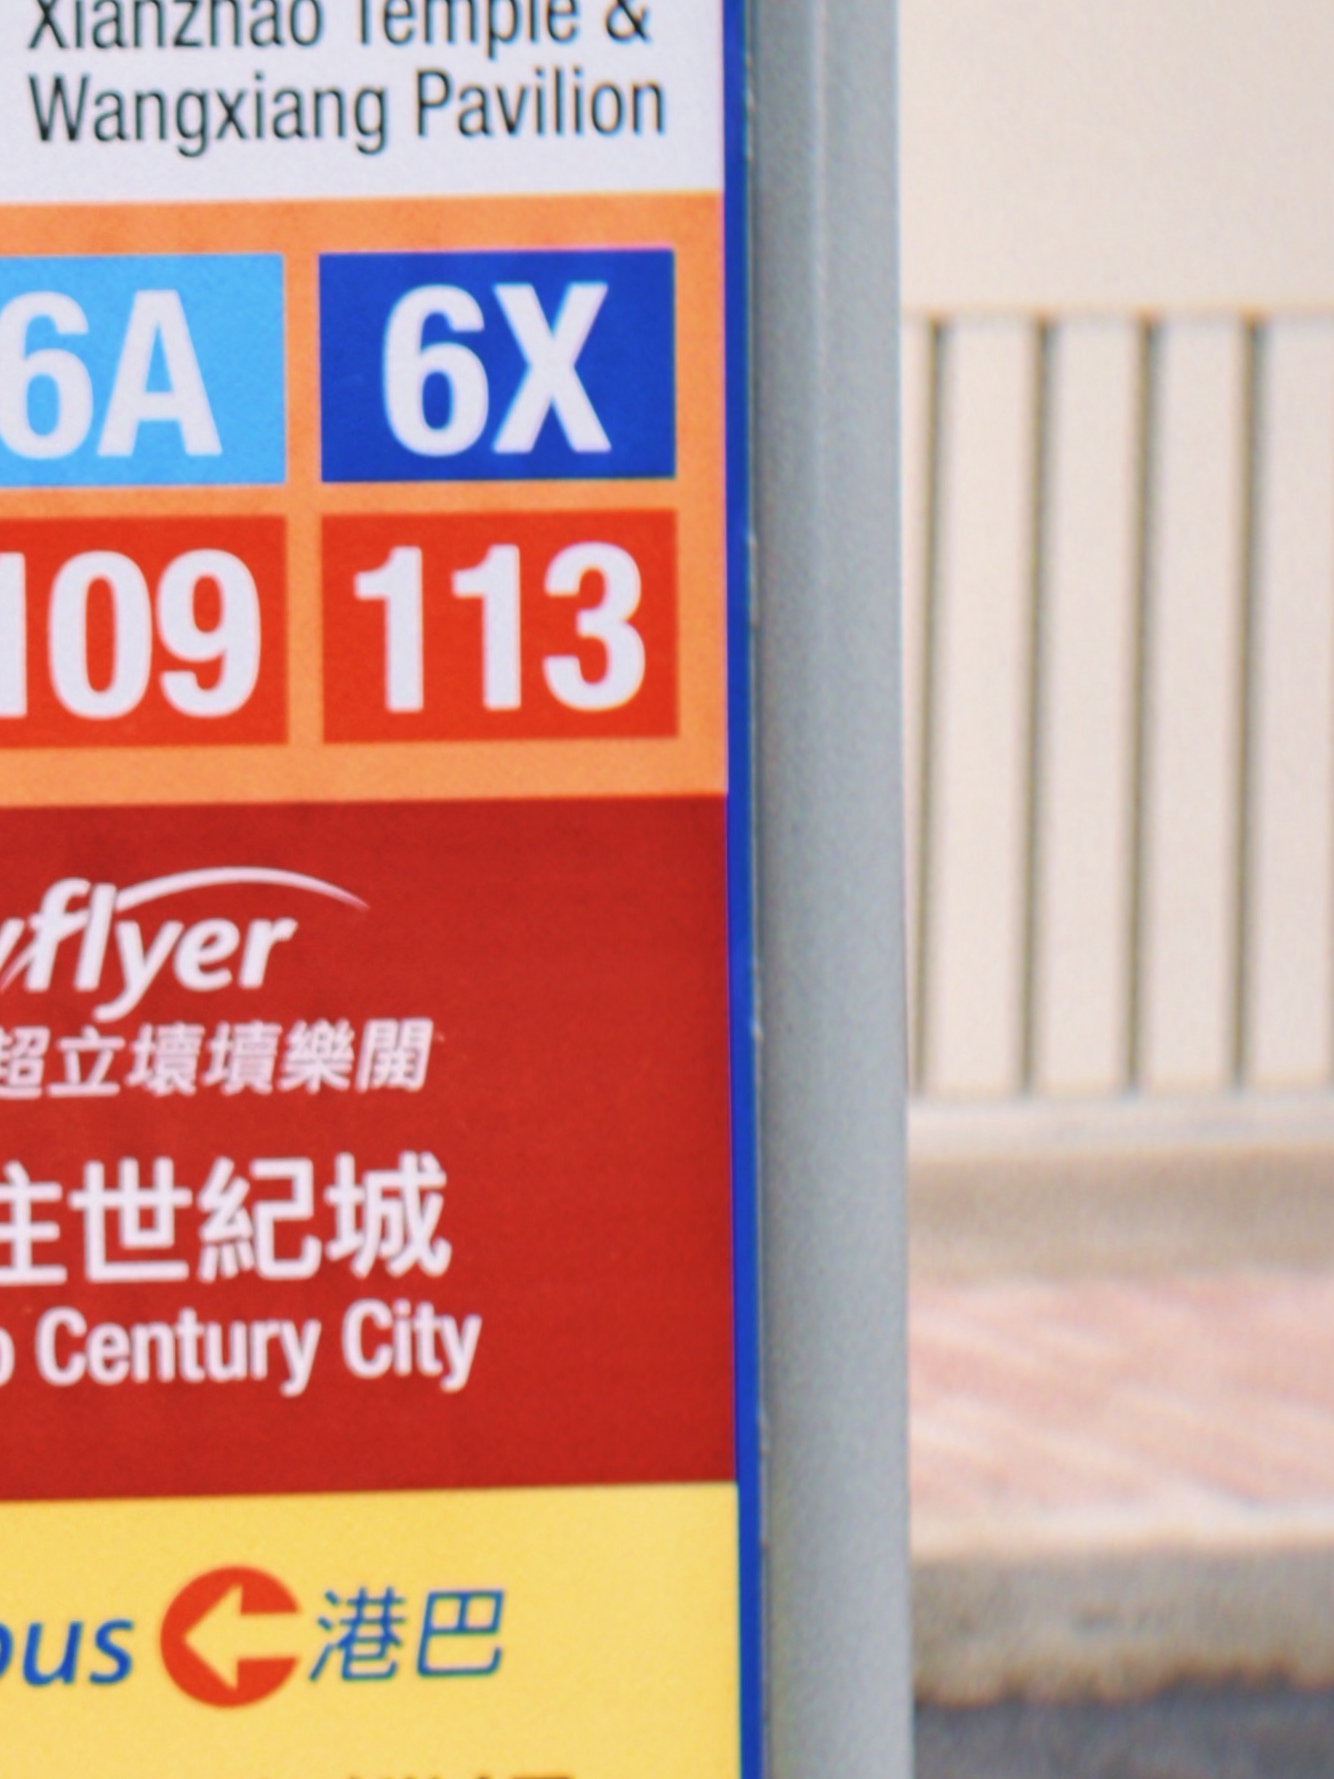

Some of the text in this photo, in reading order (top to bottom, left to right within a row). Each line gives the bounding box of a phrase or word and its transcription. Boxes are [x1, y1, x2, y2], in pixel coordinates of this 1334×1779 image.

[29, 67, 663, 158] Wangxiang Pavilion
[383, 282, 611, 456] 6X
[355, 542, 645, 712] 113
[36, 1307, 321, 1396] Century
[342, 1299, 481, 1391] City
[309, 1587, 504, 1681] 港巴
